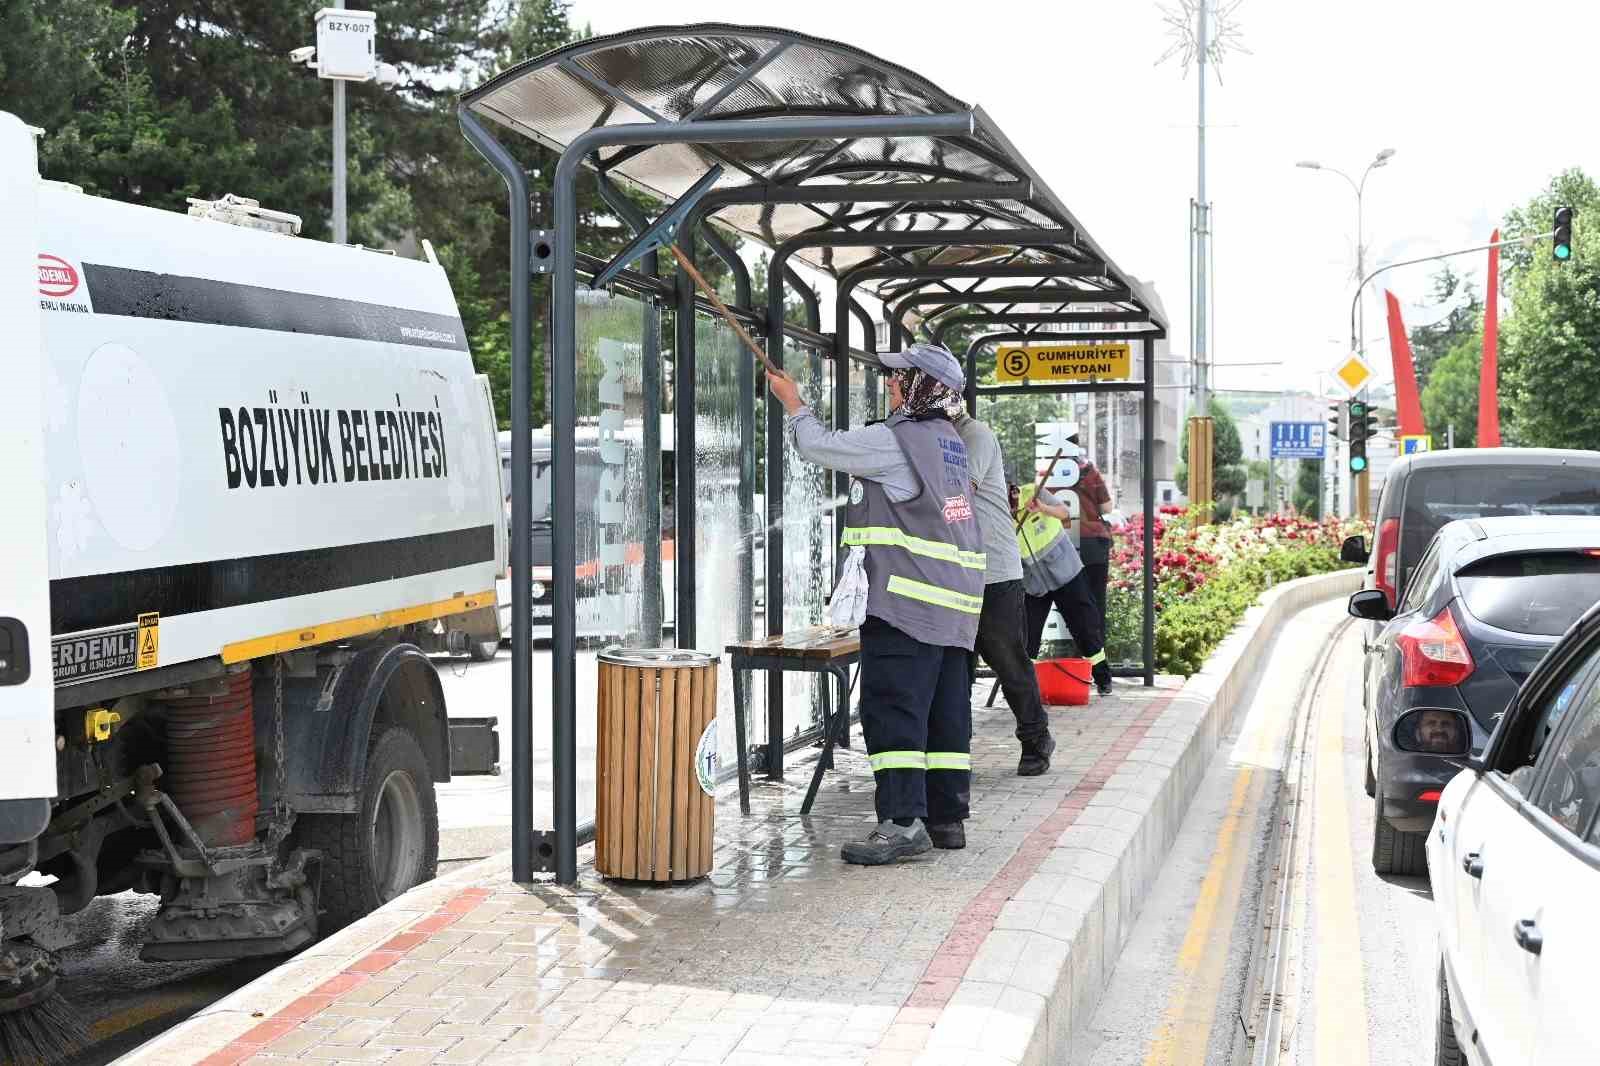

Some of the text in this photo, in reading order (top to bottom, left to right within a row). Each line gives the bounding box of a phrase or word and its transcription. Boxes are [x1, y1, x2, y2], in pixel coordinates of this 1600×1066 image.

[1037, 349, 1125, 361] CUMHURİYET
[1010, 356, 1023, 371] 5
[1051, 364, 1111, 375] MEYDANI
[218, 389, 448, 489] BOZÜYÜK BELEDİYESİ
[53, 665, 78, 678] ORUM
